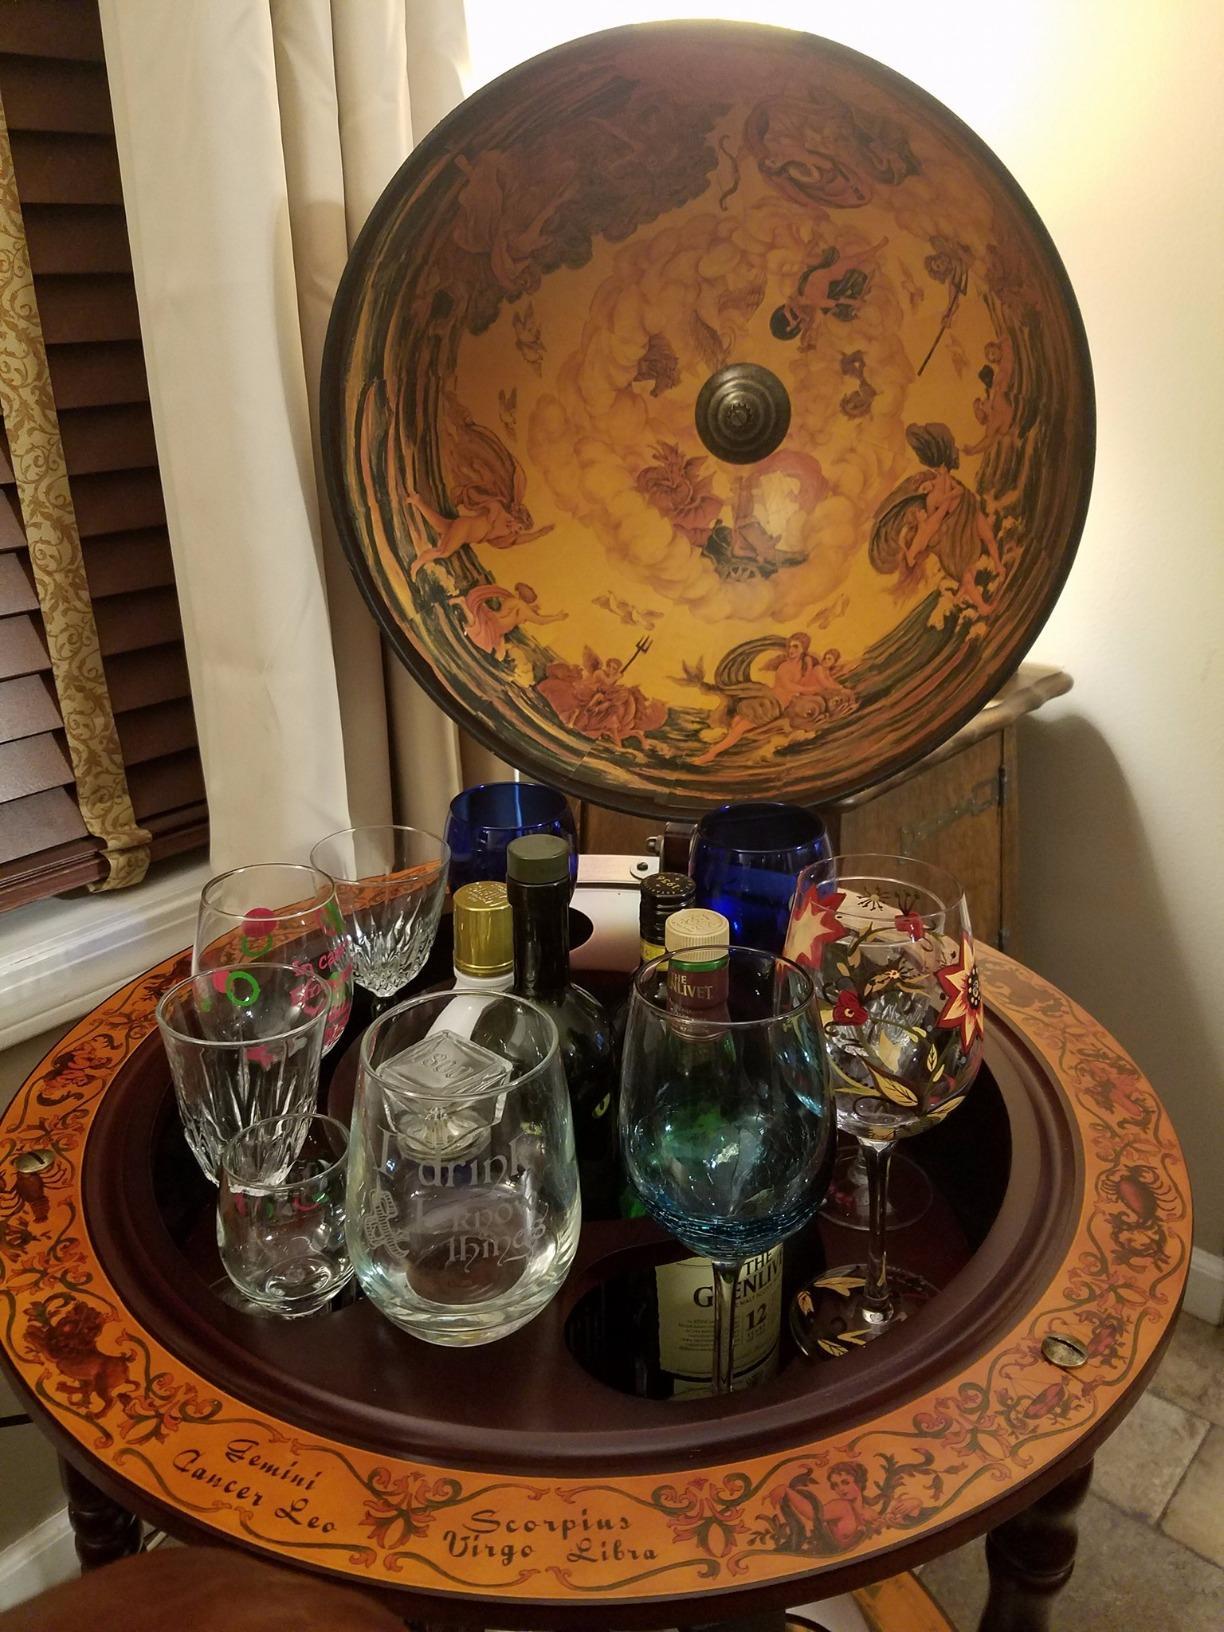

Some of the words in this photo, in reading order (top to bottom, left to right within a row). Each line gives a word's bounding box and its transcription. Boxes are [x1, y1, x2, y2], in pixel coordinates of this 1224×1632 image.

[671, 982, 713, 1000] NLIVET
[743, 1251, 772, 1275] THE
[745, 1303, 767, 1330] 12
[225, 1438, 322, 1492] Gemini
[172, 1448, 263, 1507] Cancer
[275, 1498, 336, 1534] Leo
[463, 1508, 630, 1539] Scorpius
[443, 1529, 534, 1565] Virgo
[567, 1535, 659, 1564] Libra
